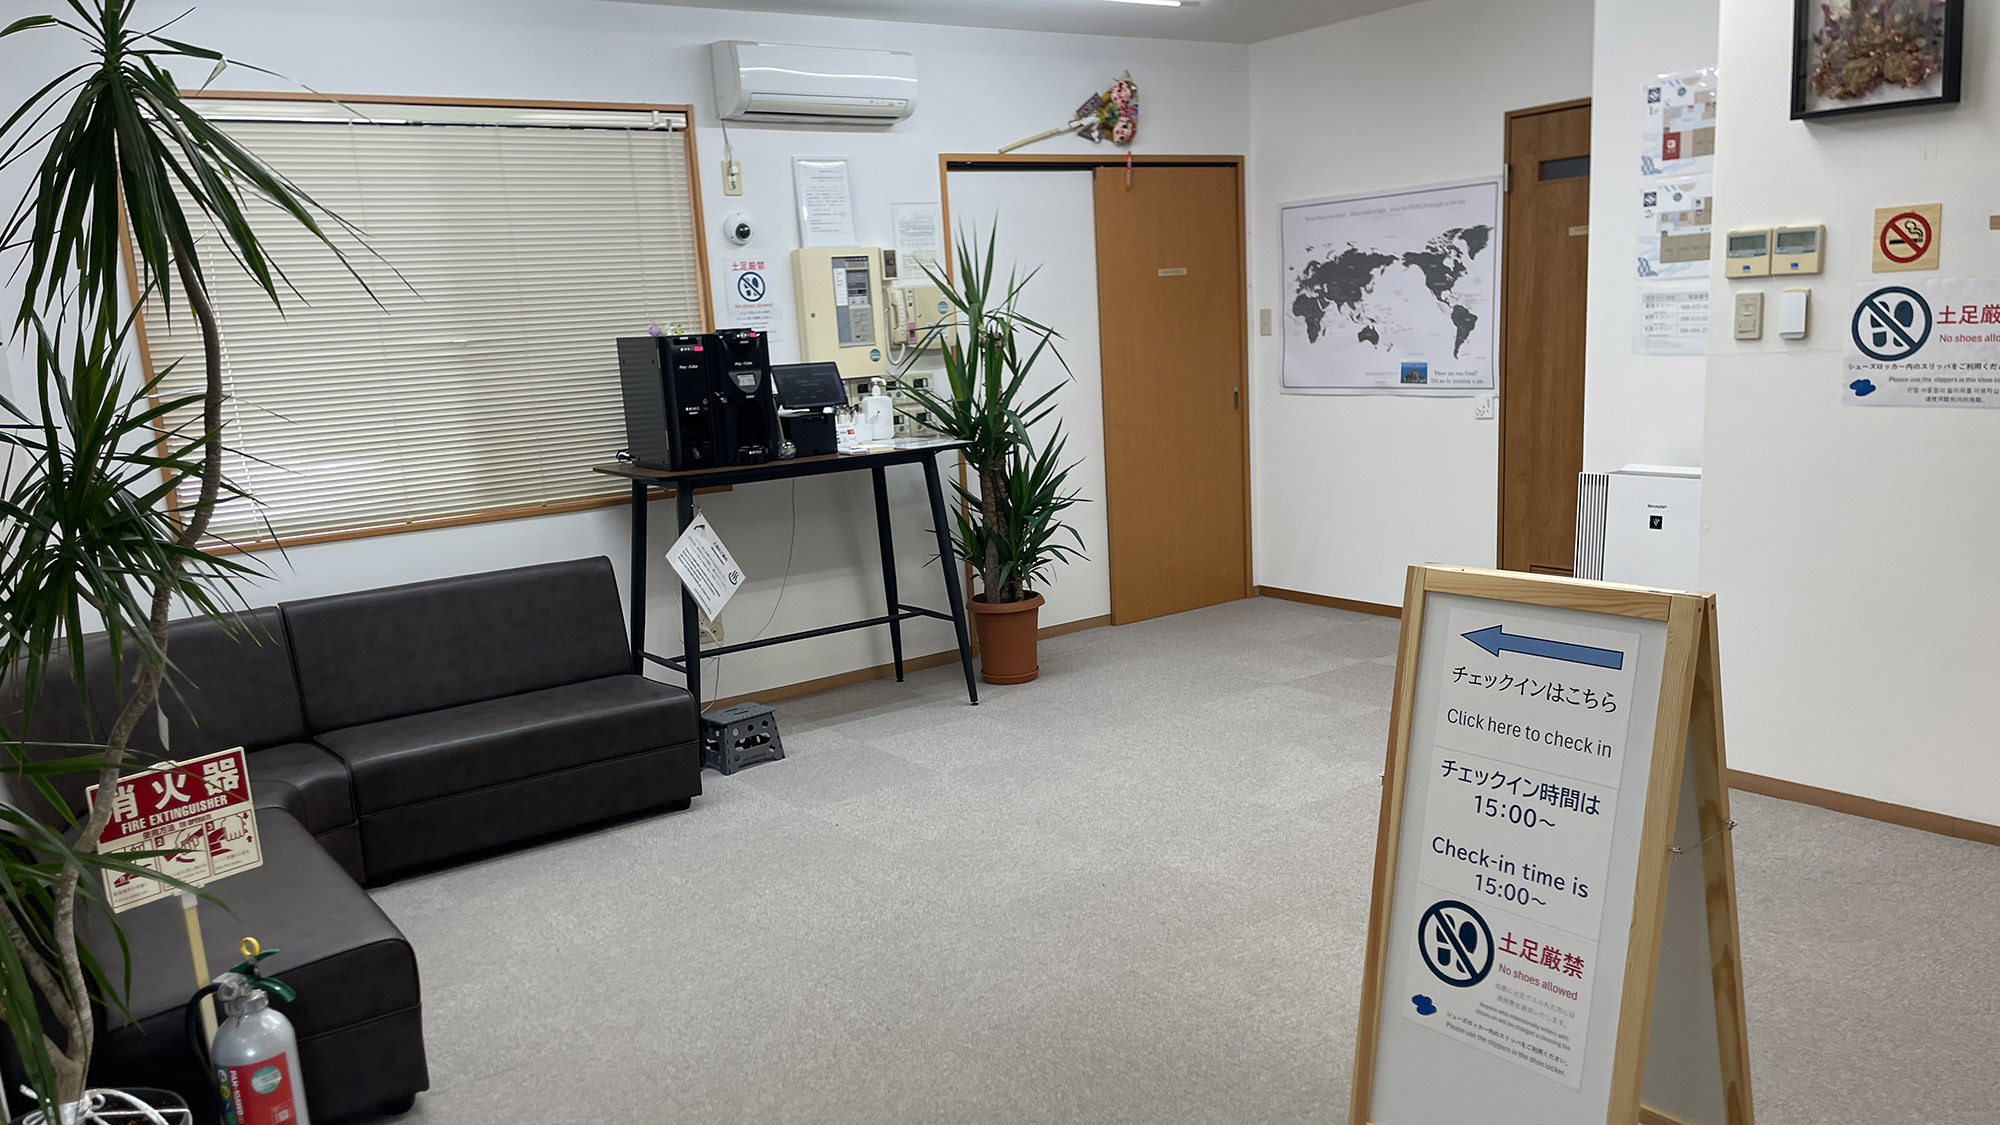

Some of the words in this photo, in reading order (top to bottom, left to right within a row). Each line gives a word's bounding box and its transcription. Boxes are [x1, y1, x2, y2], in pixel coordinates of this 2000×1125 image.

[1939, 334, 1952, 343] No
[1954, 334, 1982, 343] shoes
[1452, 665, 1618, 714] チェックインはこちら
[1447, 708, 1484, 730] Click
[1487, 715, 1521, 738] here
[1525, 724, 1541, 742] to
[1544, 729, 1593, 755] check
[1597, 740, 1612, 758] in
[1441, 759, 1601, 816] チェックイン時間は
[121, 818, 147, 835] FIRE
[149, 794, 228, 825] EXTINGUISHER
[207, 823, 214, 831] 3
[157, 838, 164, 846] 2
[1432, 836, 1516, 876] Check-in
[1522, 863, 1566, 890] time
[1572, 877, 1589, 898] is
[1498, 931, 1585, 980] 土足厳禁
[1498, 963, 1511, 976] No
[1513, 966, 1540, 988] shoes
[1542, 975, 1578, 1001] allowed
[1446, 1021, 1465, 1035] Please
[1465, 1029, 1476, 1039] use
[1477, 1033, 1488, 1043] the
[1488, 1038, 1511, 1054] slippers
[1511, 1048, 1518, 1057] in
[1518, 1050, 1528, 1060] the
[1529, 1056, 1544, 1067] shoe
